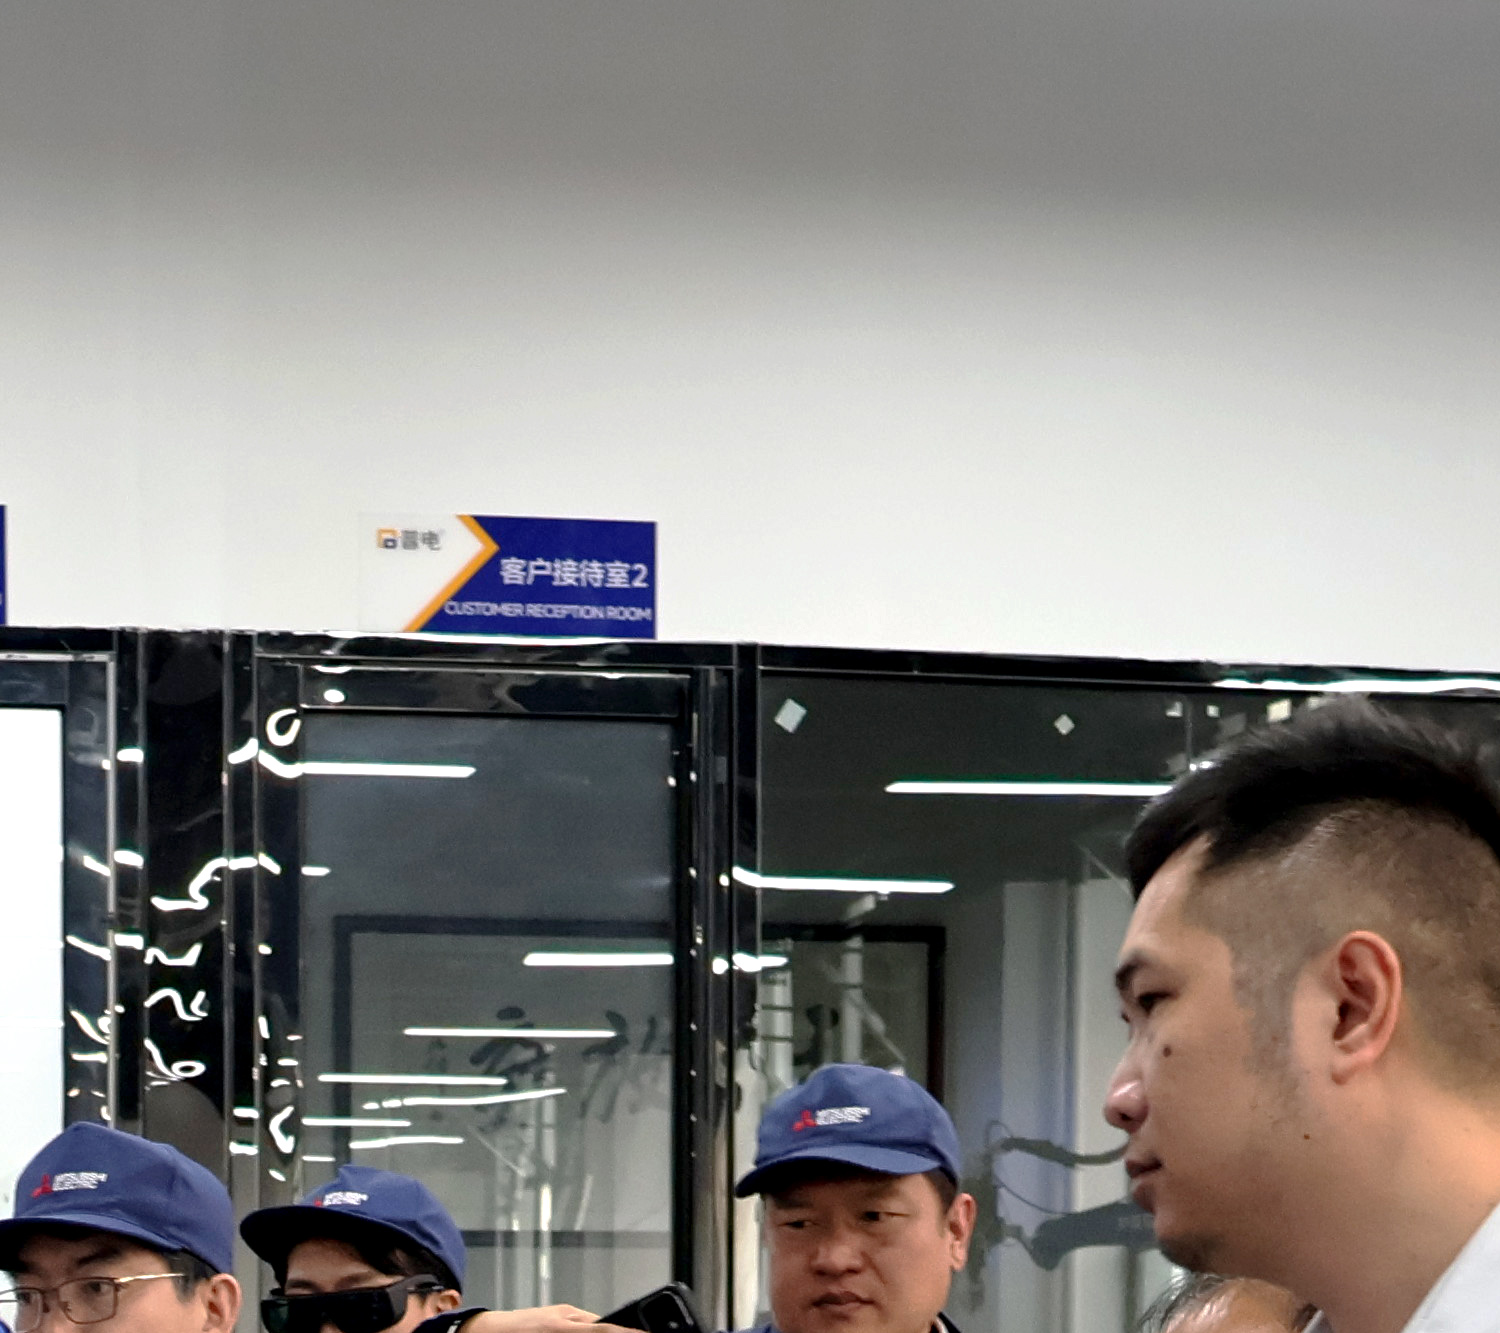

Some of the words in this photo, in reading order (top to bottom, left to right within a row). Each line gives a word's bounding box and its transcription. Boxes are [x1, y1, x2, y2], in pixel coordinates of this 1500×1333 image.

[499, 557, 649, 588] 客户接待室2
[443, 601, 526, 618] CUSTOMER
[526, 603, 603, 620] RECEPTION
[605, 605, 653, 622] ROOM
